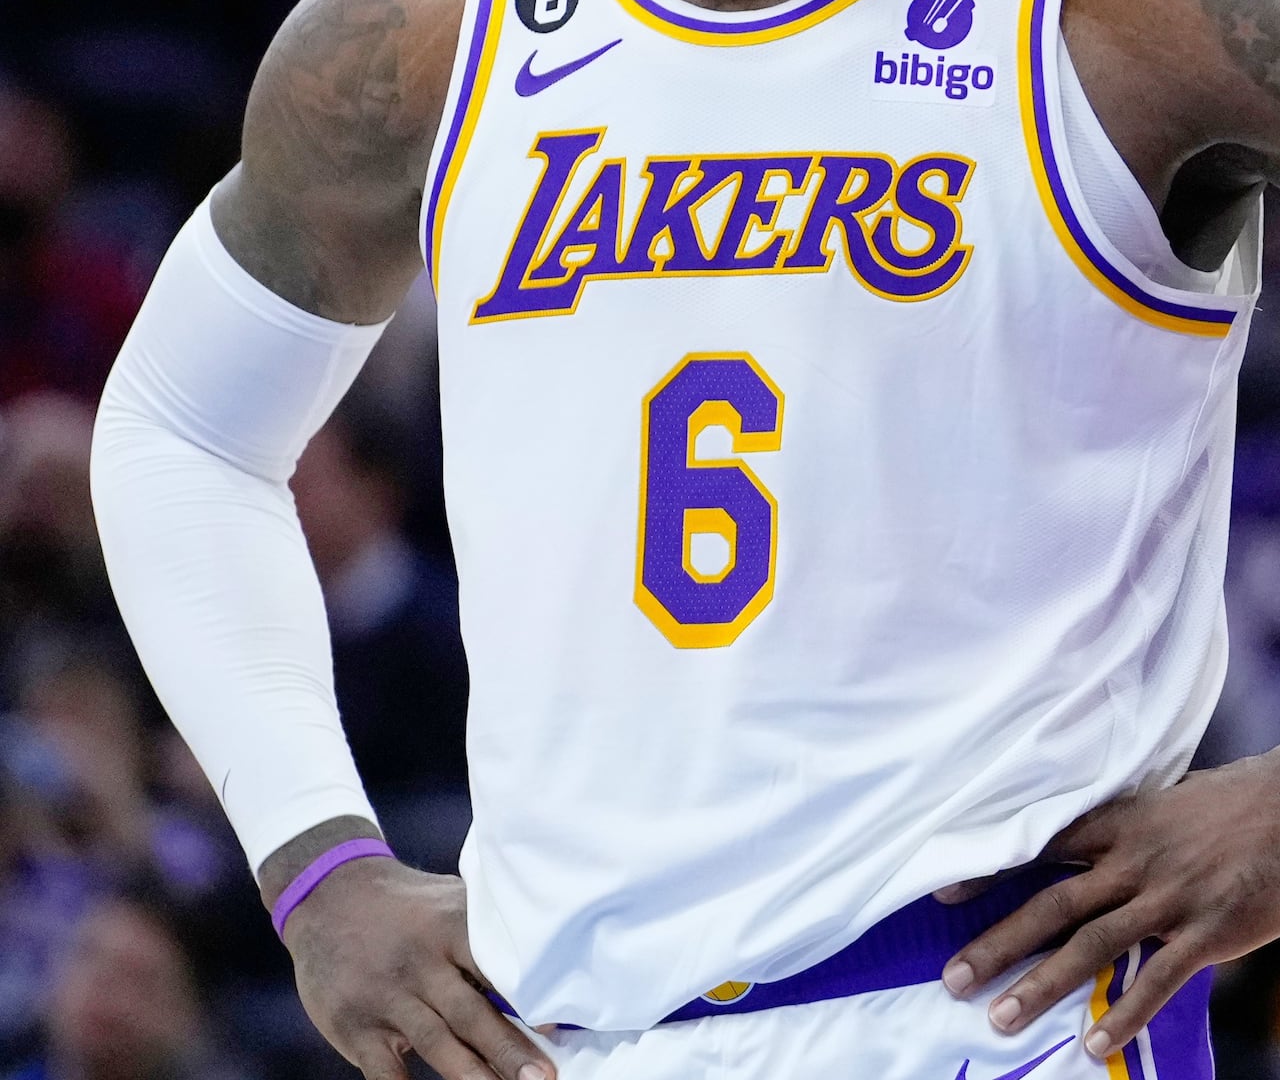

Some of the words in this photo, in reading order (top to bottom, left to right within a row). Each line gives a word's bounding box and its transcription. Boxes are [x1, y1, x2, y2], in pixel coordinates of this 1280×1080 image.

[874, 51, 994, 100] bibigo
[467, 126, 977, 325] LAKERS
[633, 350, 785, 650] 6
